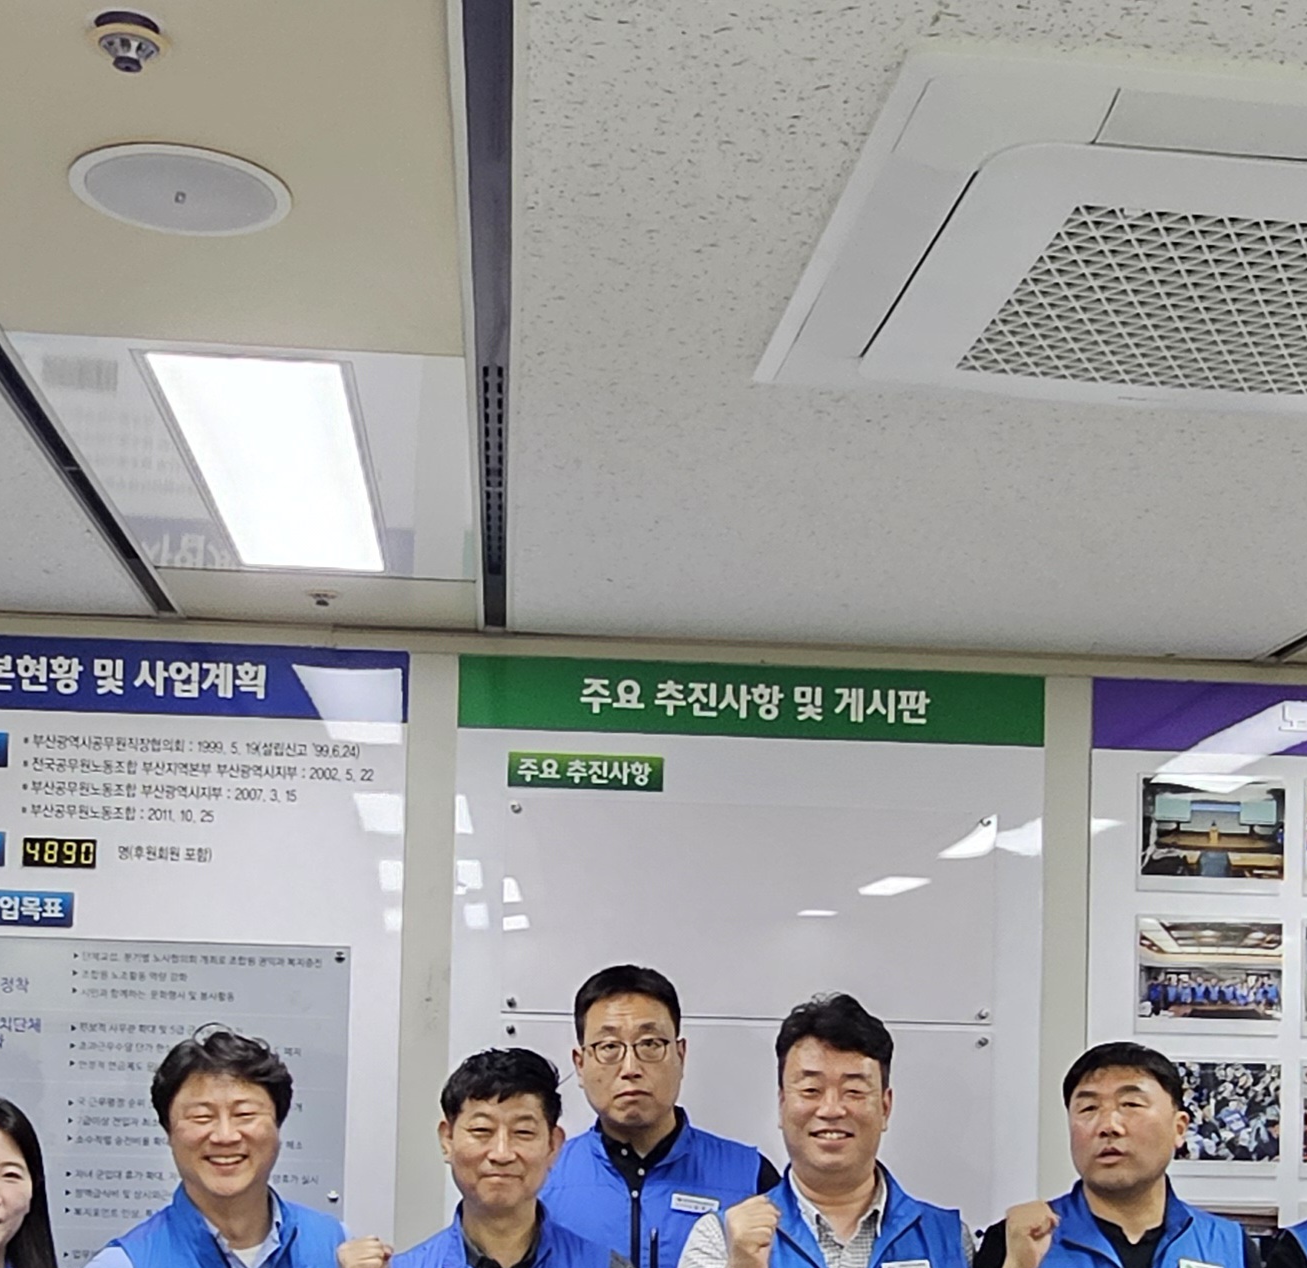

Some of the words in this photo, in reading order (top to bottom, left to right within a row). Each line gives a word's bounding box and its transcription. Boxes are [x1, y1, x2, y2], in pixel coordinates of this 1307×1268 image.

[94, 656, 125, 696] 및
[134, 659, 267, 700] 사업계획
[580, 678, 644, 714] 주요
[654, 681, 783, 720] 추진사항
[794, 686, 824, 720] 및
[834, 687, 930, 724] 게시판
[31, 757, 138, 776] 전국공무원노동조합
[142, 760, 211, 778] 부산지역본부
[216, 763, 297, 781] 부산광역시지부
[517, 759, 560, 781] 주요
[566, 760, 652, 786] 추진사항
[31, 780, 137, 798] 부산공무원노동조합
[141, 783, 223, 800] 부산광역시지부
[30, 804, 136, 822] 부산공무원노동조합
[25, 840, 94, 865] 4890
[0, 977, 30, 994] 정착
